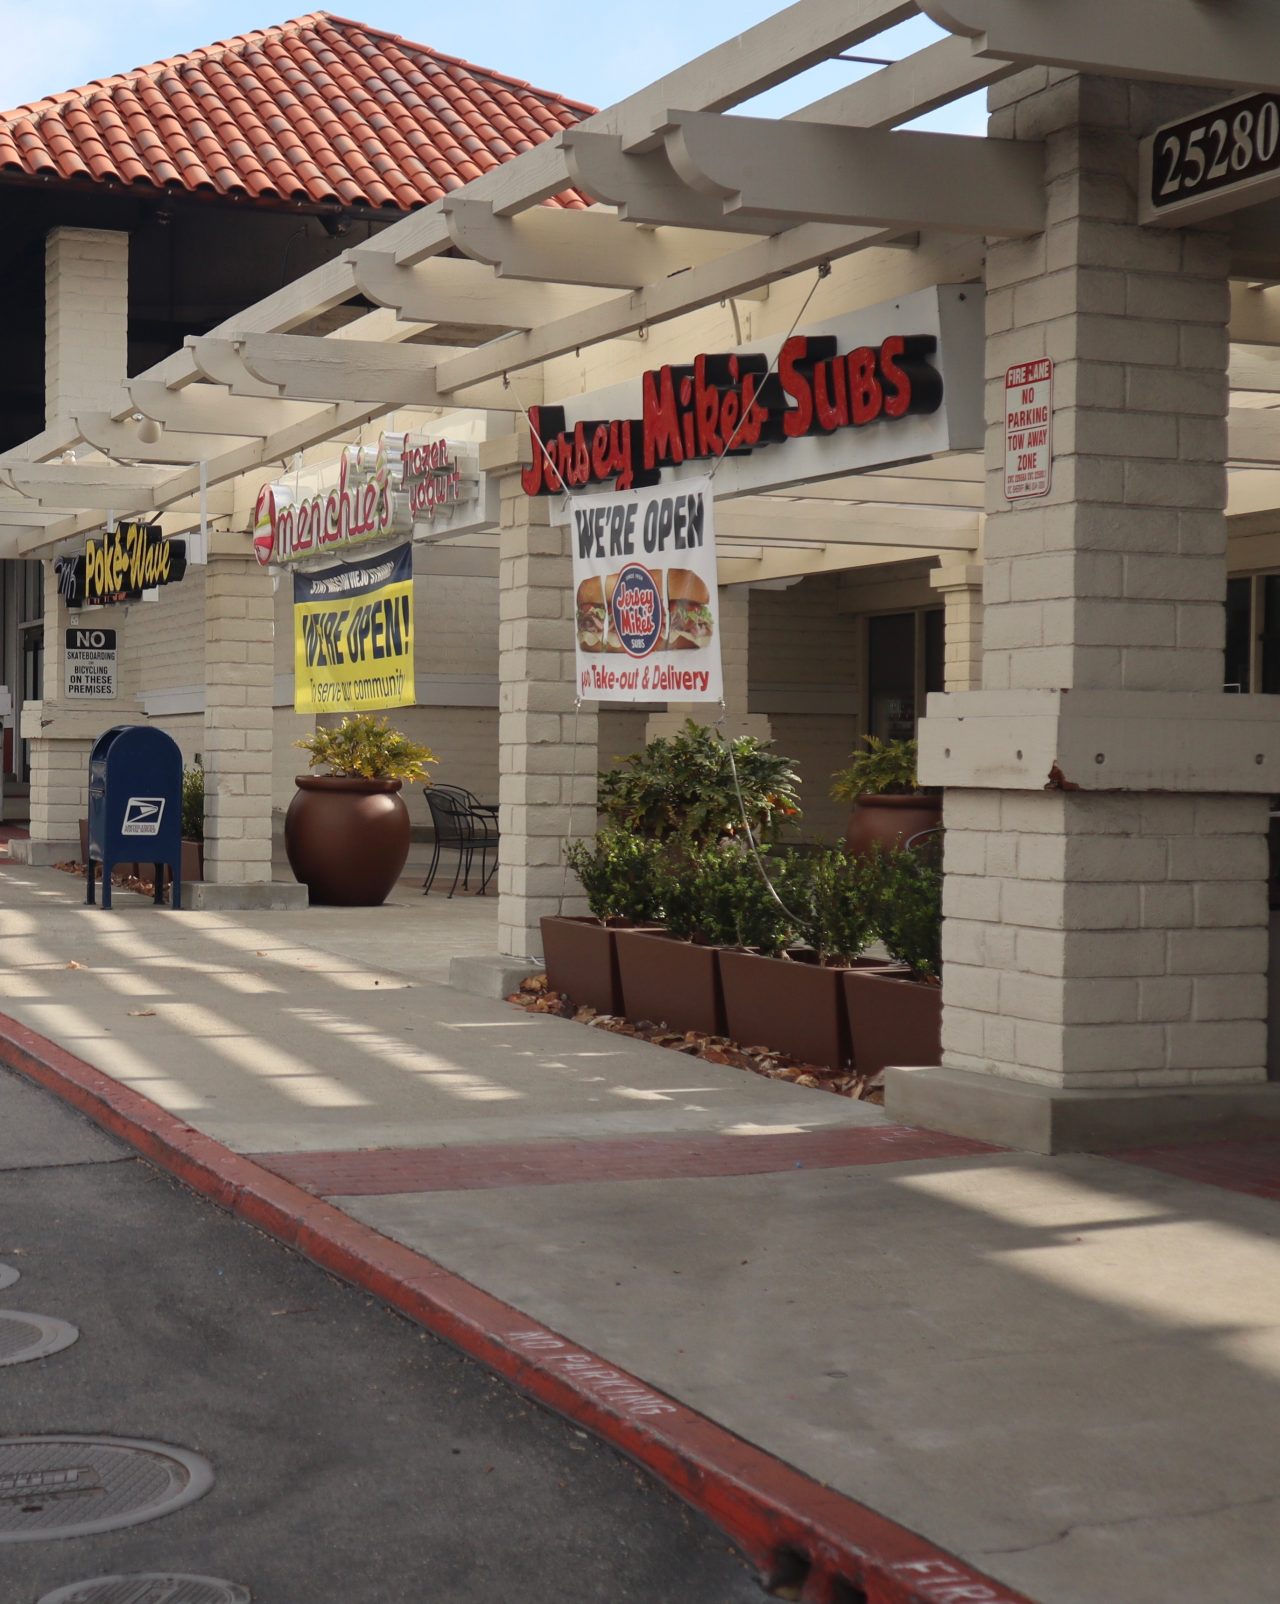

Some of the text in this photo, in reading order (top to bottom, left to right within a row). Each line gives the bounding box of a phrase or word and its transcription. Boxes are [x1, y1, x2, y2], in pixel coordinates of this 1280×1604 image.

[1159, 101, 1279, 196] 25280
[1007, 361, 1050, 386] FIRE LANE
[1022, 387, 1034, 405] NO
[521, 405, 634, 496] Jersey
[778, 335, 912, 437] SUBS
[1008, 406, 1047, 429] PARKING
[1008, 429, 1047, 451] TOW AWAY
[401, 433, 448, 490] frozen
[1018, 453, 1037, 471] ZONE
[409, 456, 459, 523] yogurt
[575, 493, 704, 559] WE'RE OPEN
[617, 582, 654, 615] Jersey
[76, 631, 106, 647] NO
[347, 595, 409, 663] OPEN!
[67, 651, 115, 660] SKATEBOARDING
[70, 675, 112, 684] ON THESE
[74, 666, 108, 674] BICYCLING
[591, 665, 639, 690] Take-out
[641, 665, 650, 690] &
[652, 665, 709, 692] Delivery
[317, 682, 341, 702] serve
[353, 668, 405, 701] community
[506, 1331, 677, 1415] NO PARKING
